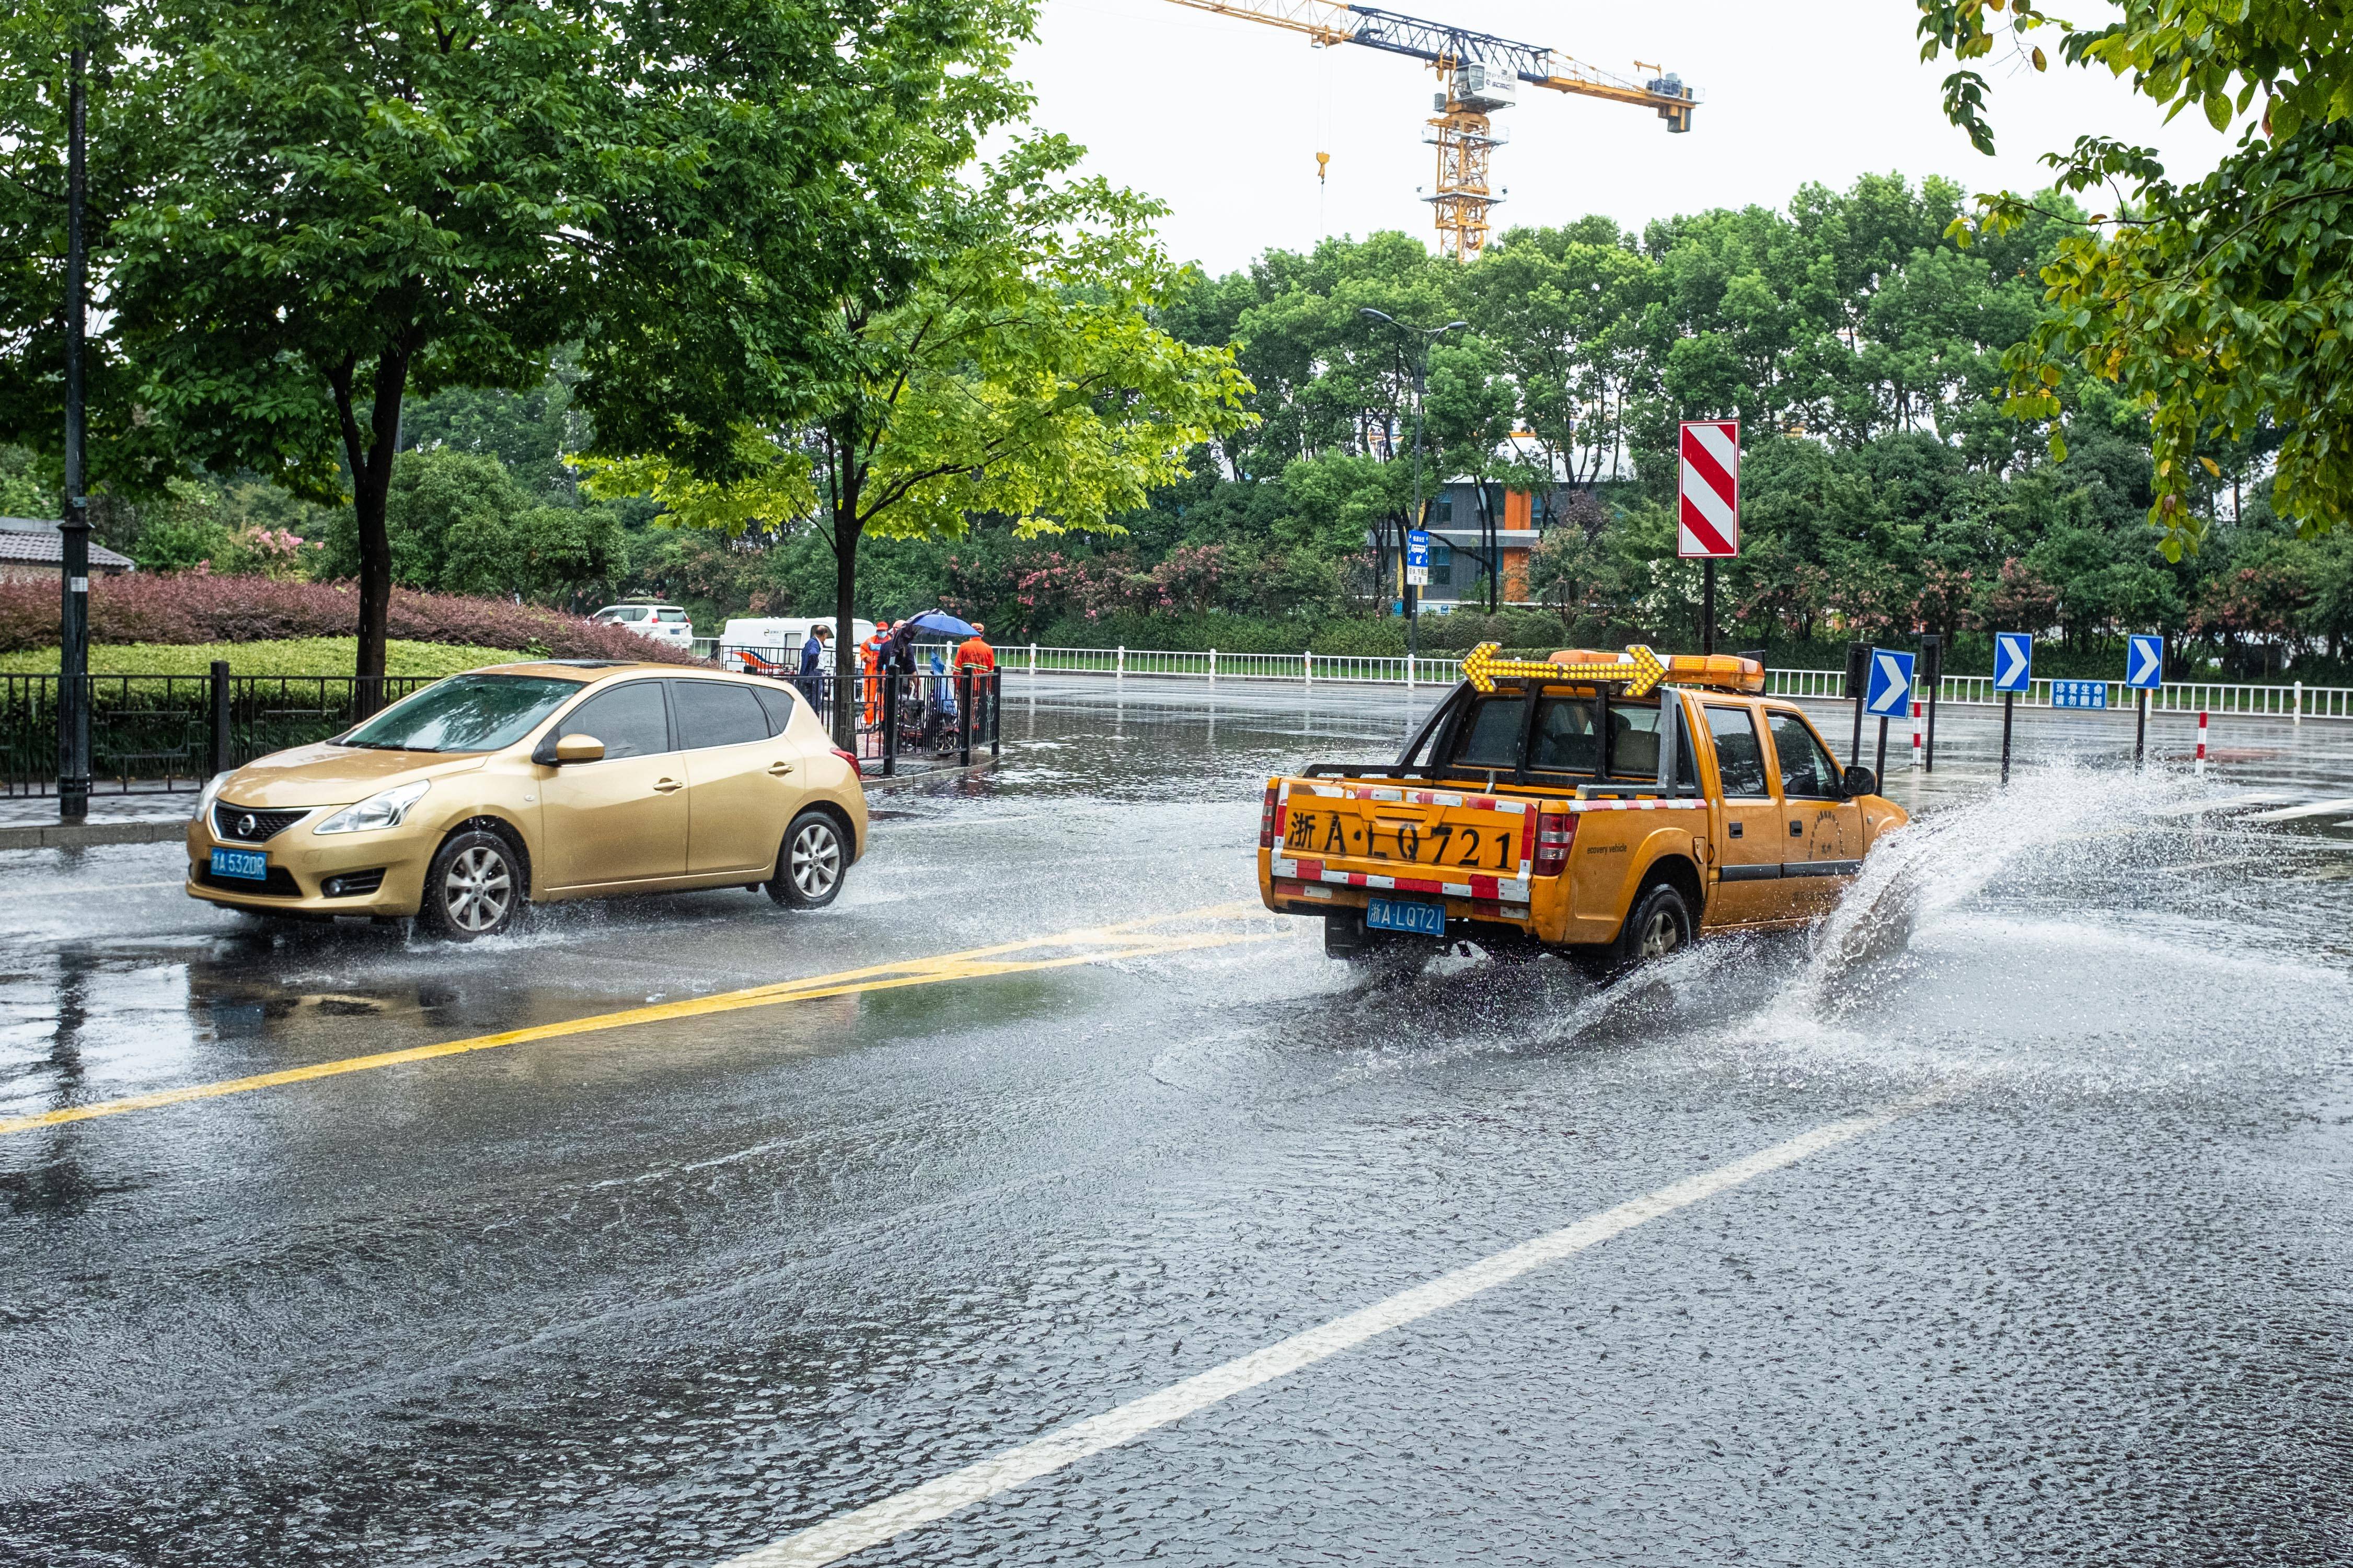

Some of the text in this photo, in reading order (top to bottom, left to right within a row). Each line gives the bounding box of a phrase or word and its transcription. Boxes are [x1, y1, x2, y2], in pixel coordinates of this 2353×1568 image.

[2056, 682, 2103, 695] 珍爱生命
[2055, 694, 2102, 707] 请勿翻越
[1609, 843, 1627, 853] vehicle
